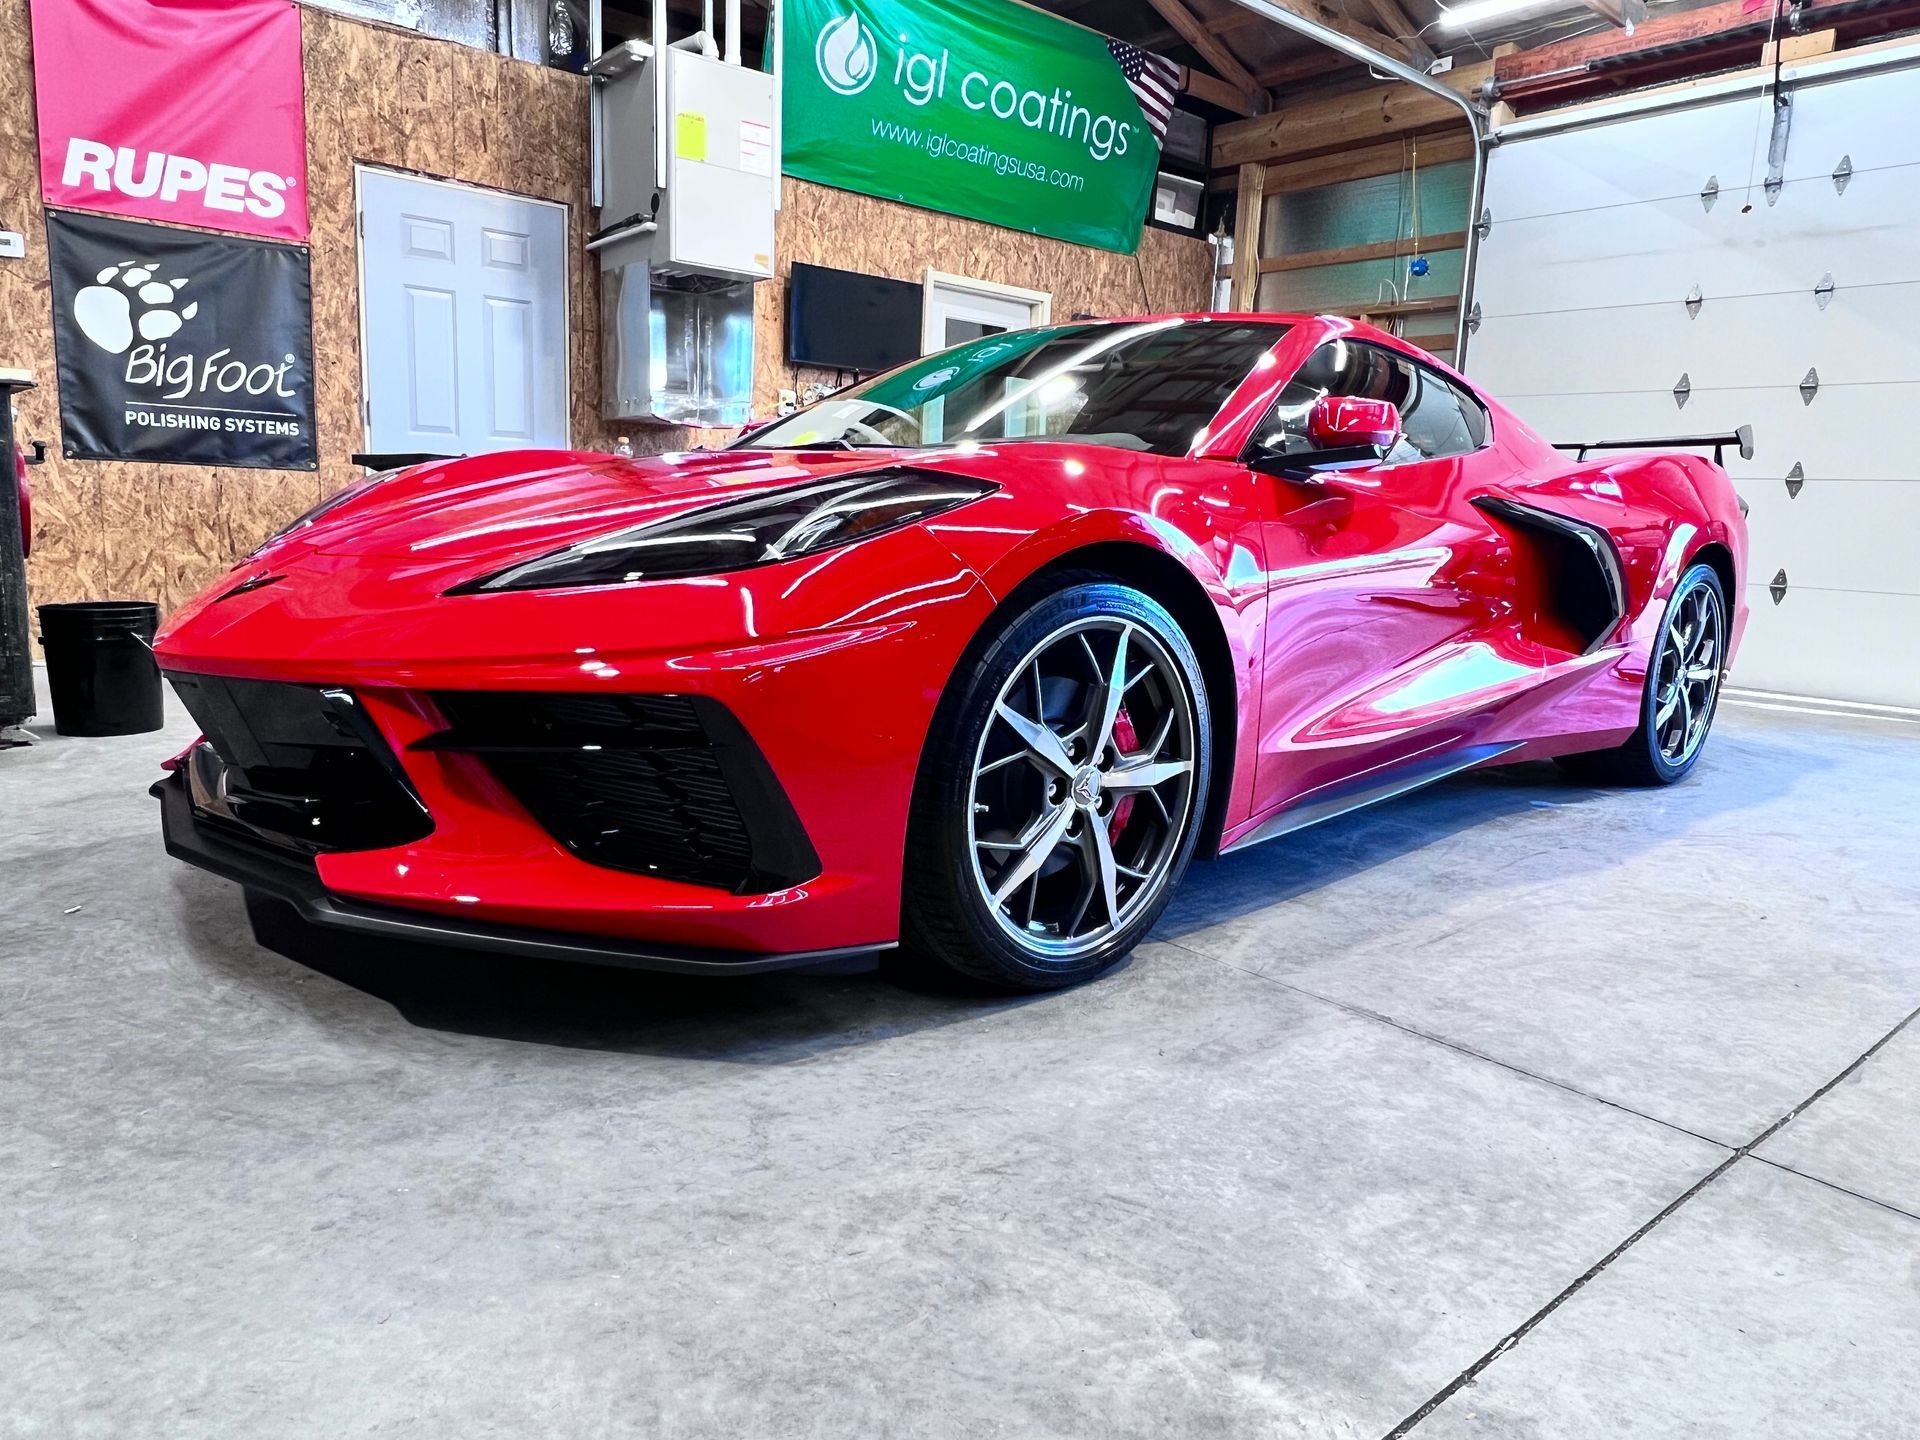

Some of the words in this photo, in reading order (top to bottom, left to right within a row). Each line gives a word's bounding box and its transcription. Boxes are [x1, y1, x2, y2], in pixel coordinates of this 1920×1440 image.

[894, 33, 949, 106] igl
[960, 71, 1131, 161] coatings
[61, 137, 287, 219] RUPES
[871, 118, 1084, 192] www.iglcoatingsusa.com
[125, 410, 221, 431] POLISHING
[224, 417, 300, 436] SYSTEMS
